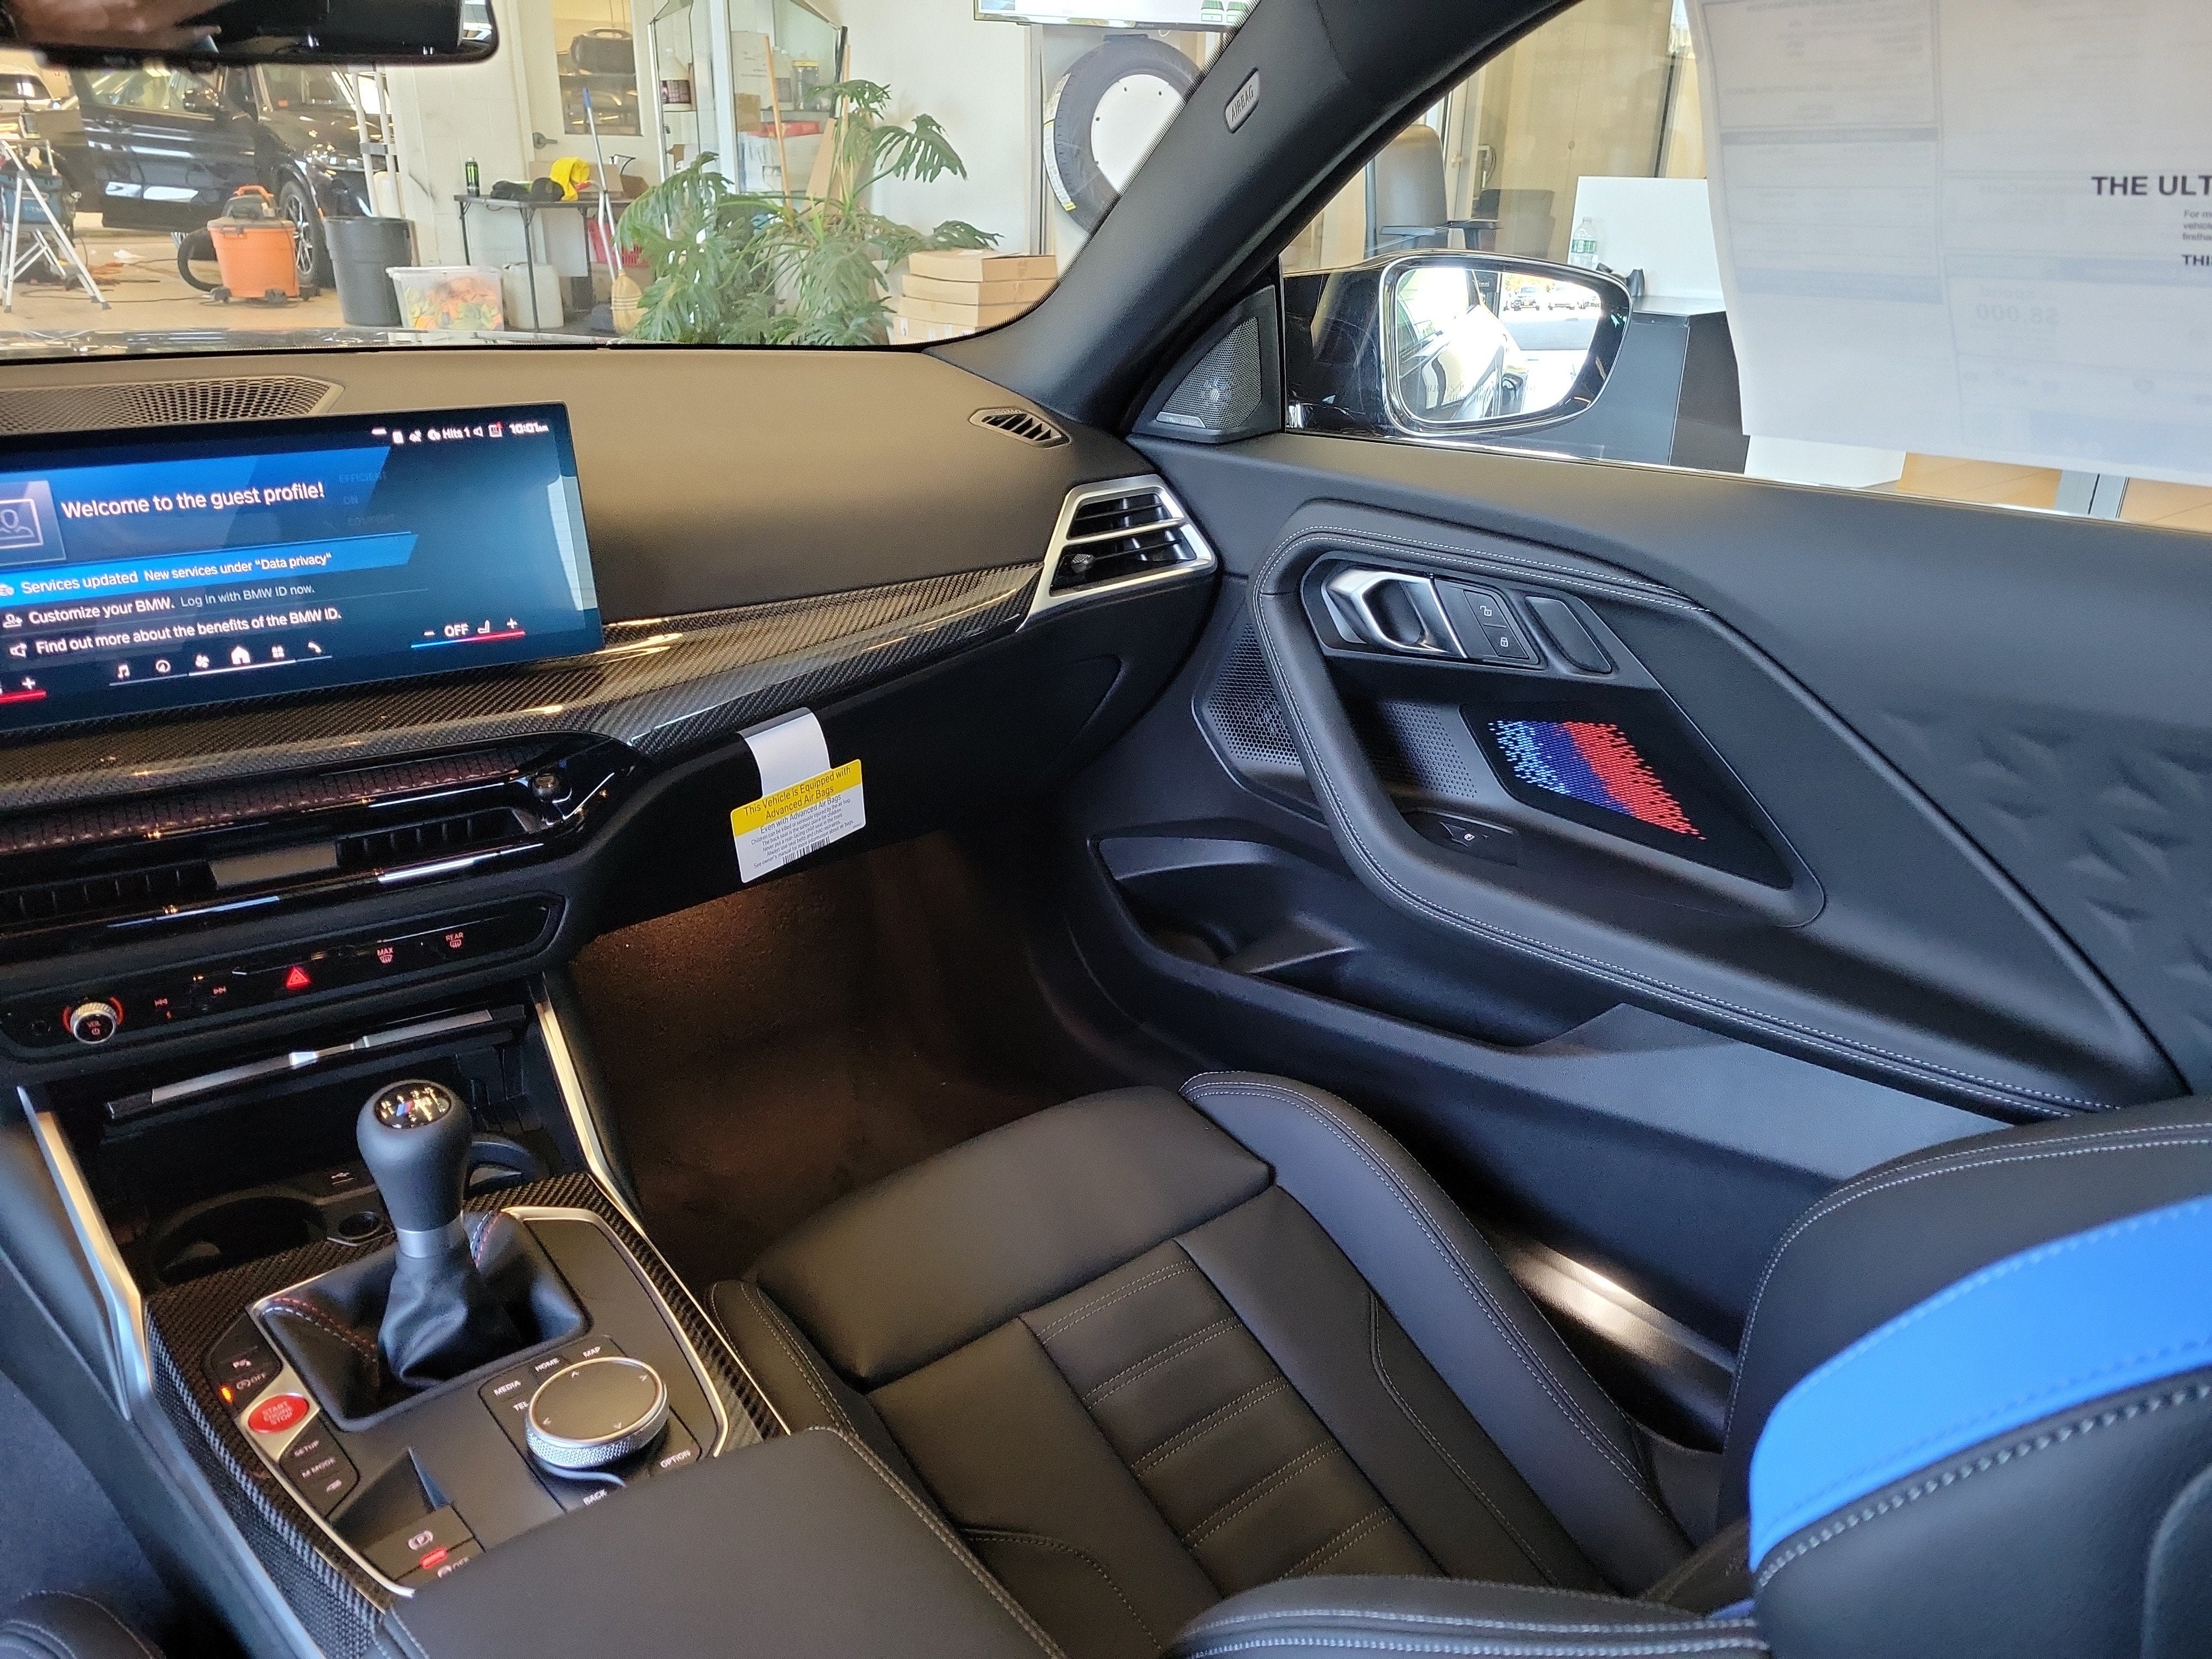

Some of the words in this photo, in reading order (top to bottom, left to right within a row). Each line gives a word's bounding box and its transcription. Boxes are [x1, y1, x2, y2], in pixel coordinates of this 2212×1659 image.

[1231, 84, 1254, 122] AIRBAG
[2091, 176, 2148, 196] THE
[2183, 210, 2199, 218] For
[2182, 254, 2212, 266] THI
[442, 427, 463, 439] Hits
[464, 427, 470, 437] 1
[62, 498, 149, 519] Welcome
[153, 495, 173, 511] to
[177, 492, 206, 509] the
[211, 487, 261, 510] guest
[264, 481, 325, 507] profile!
[21, 578, 80, 594] Services
[83, 571, 138, 589] updated
[144, 569, 169, 581] New
[172, 566, 218, 579] services
[220, 561, 252, 574] under
[29, 607, 100, 624] Customize
[102, 603, 133, 618] your
[136, 597, 175, 612] BMW.
[180, 596, 202, 607] Log
[218, 590, 241, 603] with
[243, 587, 272, 600] BMW
[275, 586, 287, 596] ID
[290, 584, 315, 595] now.
[36, 640, 67, 654] Find
[69, 636, 93, 651] out
[95, 631, 130, 646] more
[133, 627, 172, 643] about
[173, 625, 195, 638] the
[197, 618, 250, 635] benefits
[251, 616, 265, 628] of
[266, 614, 287, 627] the
[290, 609, 322, 624] BMW
[324, 607, 342, 619] ID.
[444, 623, 468, 638] OFF
[744, 804, 761, 816] This
[762, 792, 791, 809] Vehicle
[792, 788, 798, 797] is
[799, 772, 834, 794] Equipped
[836, 766, 851, 778] with
[766, 798, 802, 820] Advanced
[804, 793, 814, 804] Air
[816, 785, 834, 800] Bags
[760, 822, 775, 834] Even
[776, 816, 788, 827] with
[789, 805, 817, 822] Advanced
[827, 794, 841, 805] Bags
[751, 834, 768, 845] Children
[797, 814, 813, 825] seriously
[814, 809, 826, 819] injured
[770, 835, 780, 843] back
[799, 820, 811, 830] safest
[811, 816, 821, 826] place
[762, 854, 777, 865] owner's
[777, 847, 792, 859] manual
[798, 840, 808, 849] more
[808, 831, 828, 844] information
[829, 825, 839, 834] about
[763, 843, 774, 853] Never
[805, 825, 815, 833] child
[766, 847, 780, 856] Always
[797, 835, 806, 843] belts
[445, 932, 464, 942] REAR
[377, 946, 394, 957] MAX
[583, 1346, 601, 1358] MAP
[534, 1357, 560, 1373] HOME
[493, 1379, 522, 1396] MEDIA
[262, 1401, 289, 1415] START
[513, 1400, 529, 1412] TEL
[270, 1411, 292, 1425] STOP
[294, 1440, 319, 1457] SETUP
[311, 1457, 335, 1474] MODE
[660, 1449, 691, 1469] OPTION
[583, 1488, 608, 1506] BACK
